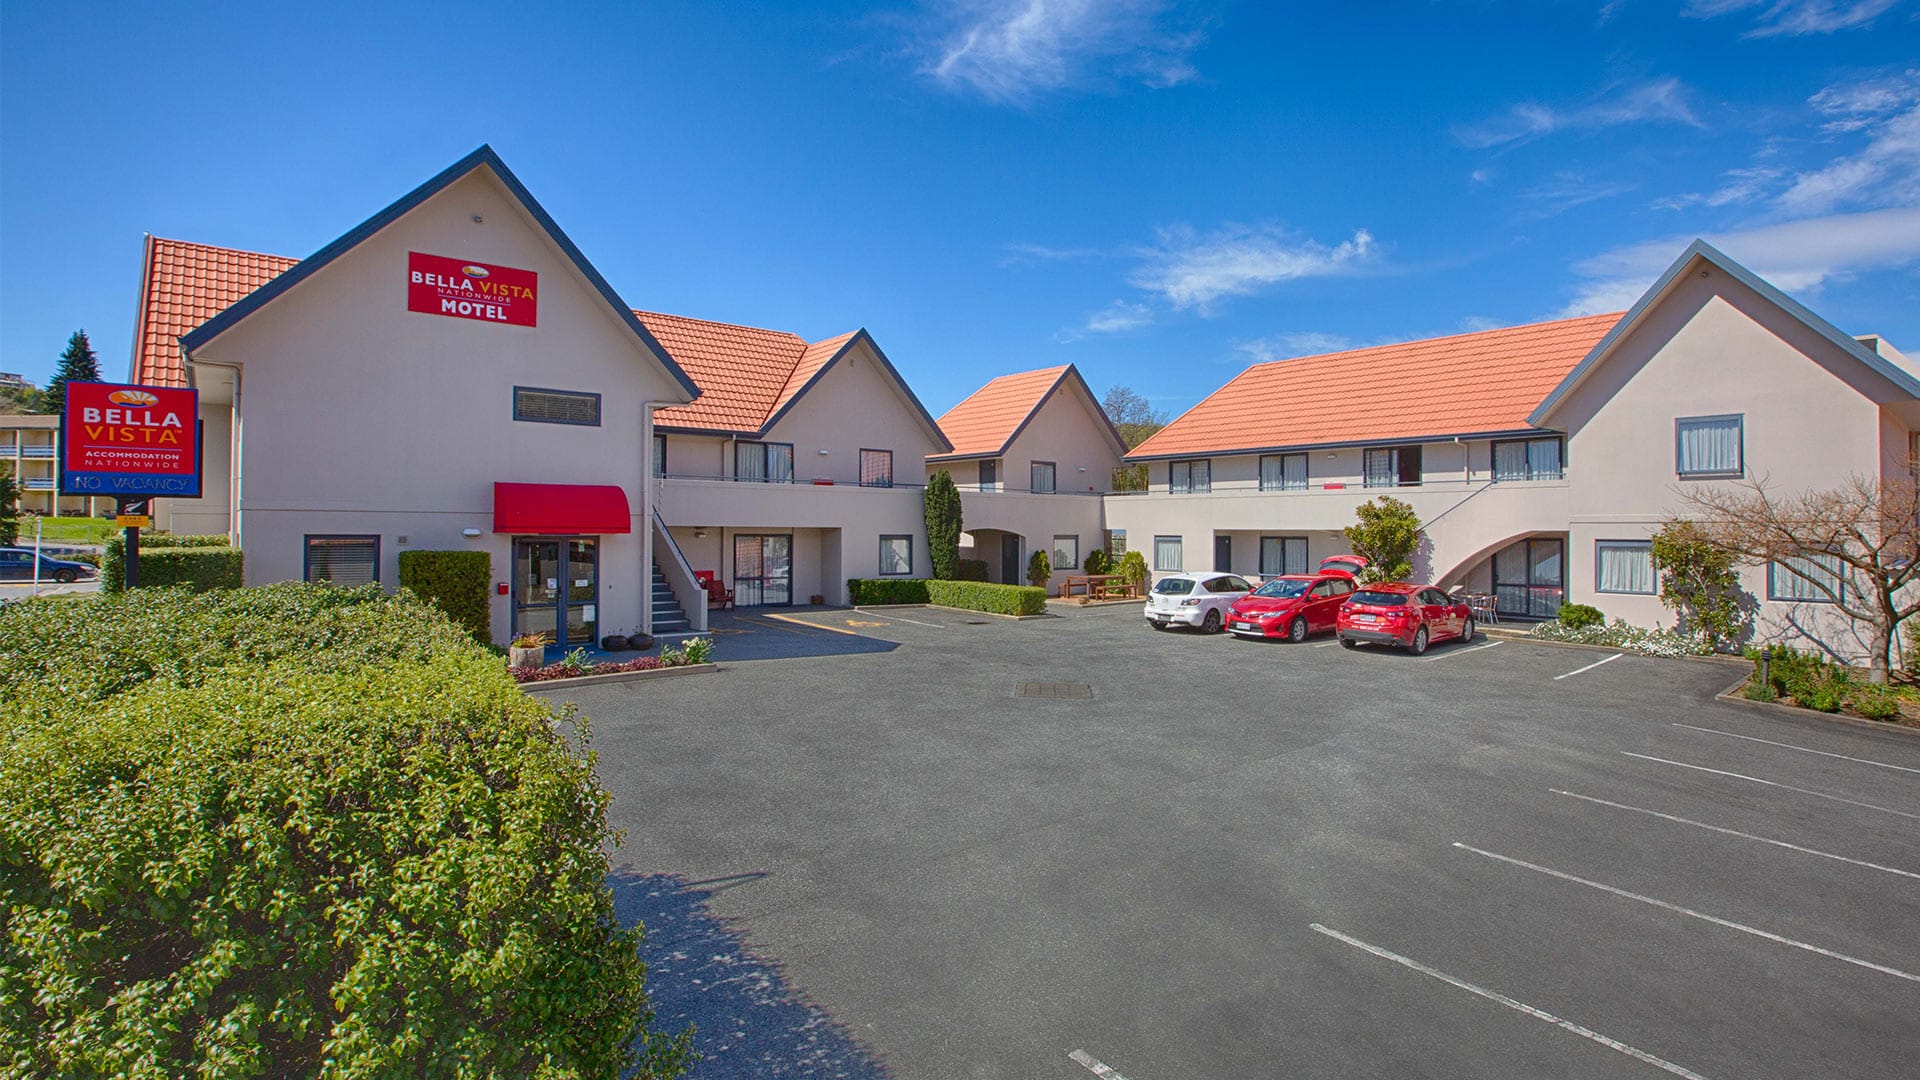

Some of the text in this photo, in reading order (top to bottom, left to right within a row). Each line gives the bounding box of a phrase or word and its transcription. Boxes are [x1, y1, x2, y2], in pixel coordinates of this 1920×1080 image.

[411, 271, 535, 301] BELLA VISTA
[437, 287, 511, 303] NATIONWIDE
[441, 298, 507, 320] MOTEL
[83, 407, 183, 428] BELLA
[85, 450, 180, 460] ACCOMMODATION
[84, 459, 180, 469] NATIONWIDE
[74, 476, 190, 491] NO VACANCY
